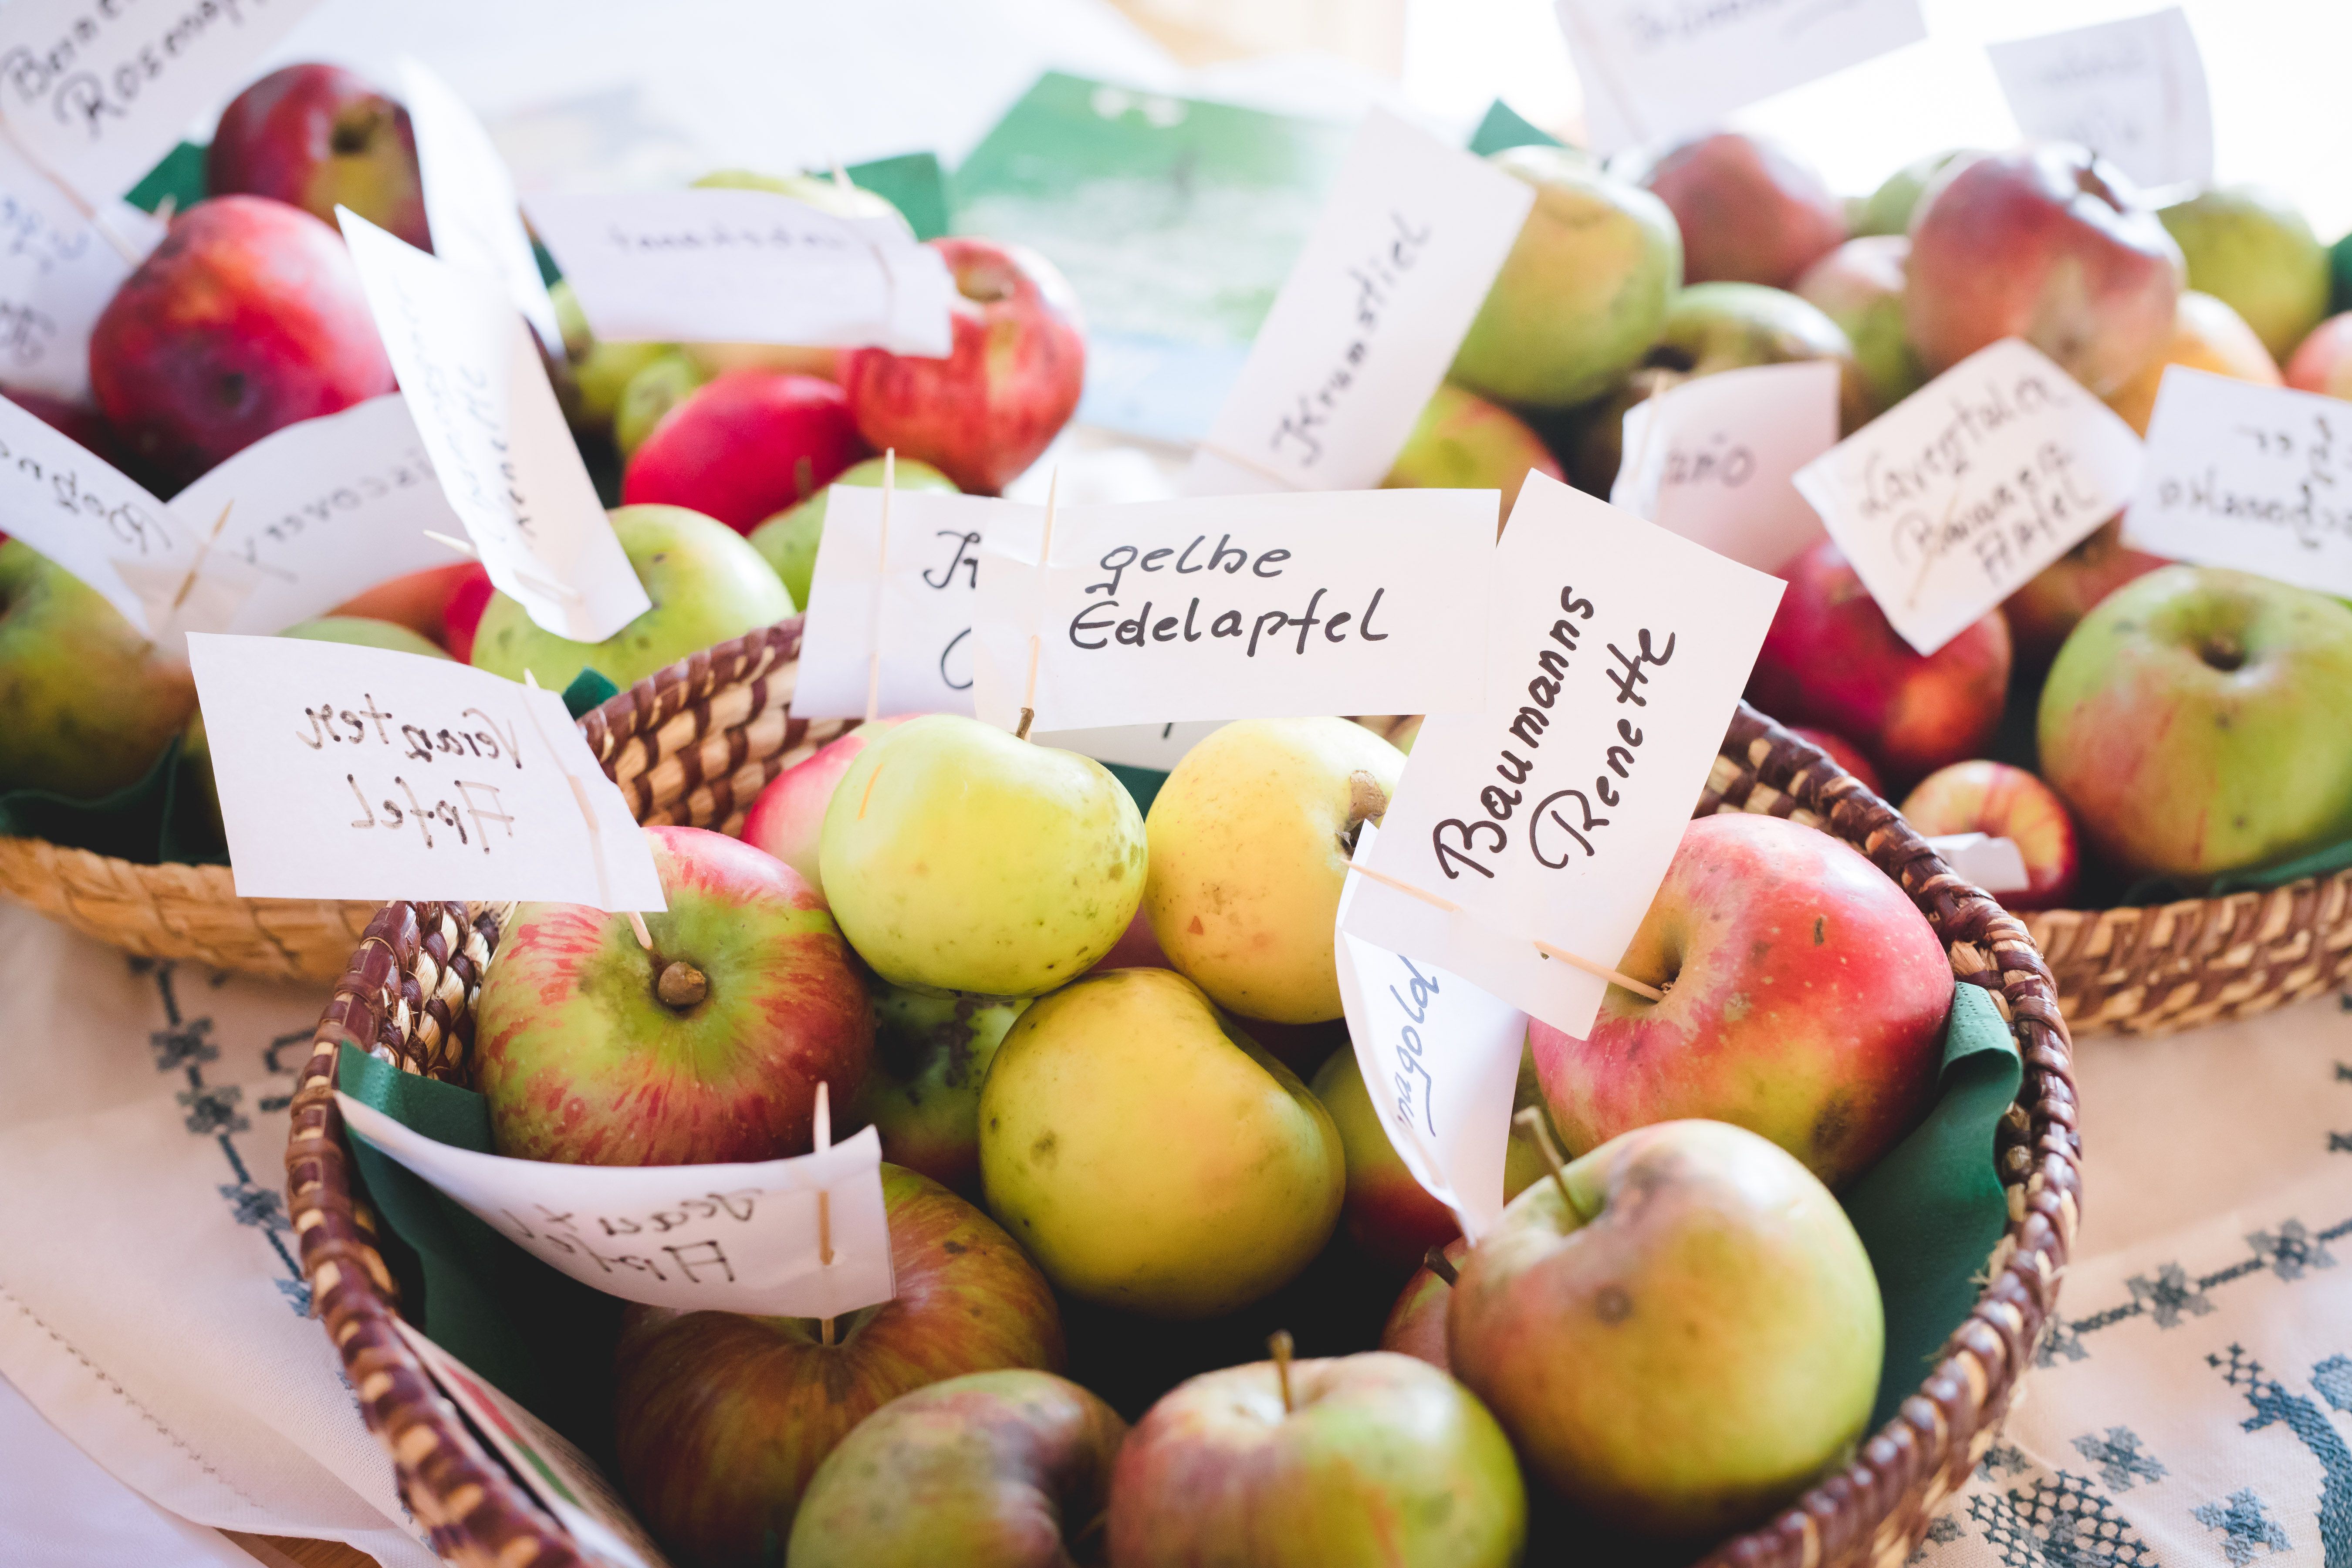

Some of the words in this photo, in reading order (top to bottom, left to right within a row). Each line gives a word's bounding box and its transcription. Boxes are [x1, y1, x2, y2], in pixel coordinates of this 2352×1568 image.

[1068, 587, 1389, 657] Edelapfel
[1085, 533, 1292, 596] gelbe
[1433, 585, 1594, 879] Baumanns
[1529, 629, 1675, 869] Renette
[1389, 954, 1440, 1137] nagold
